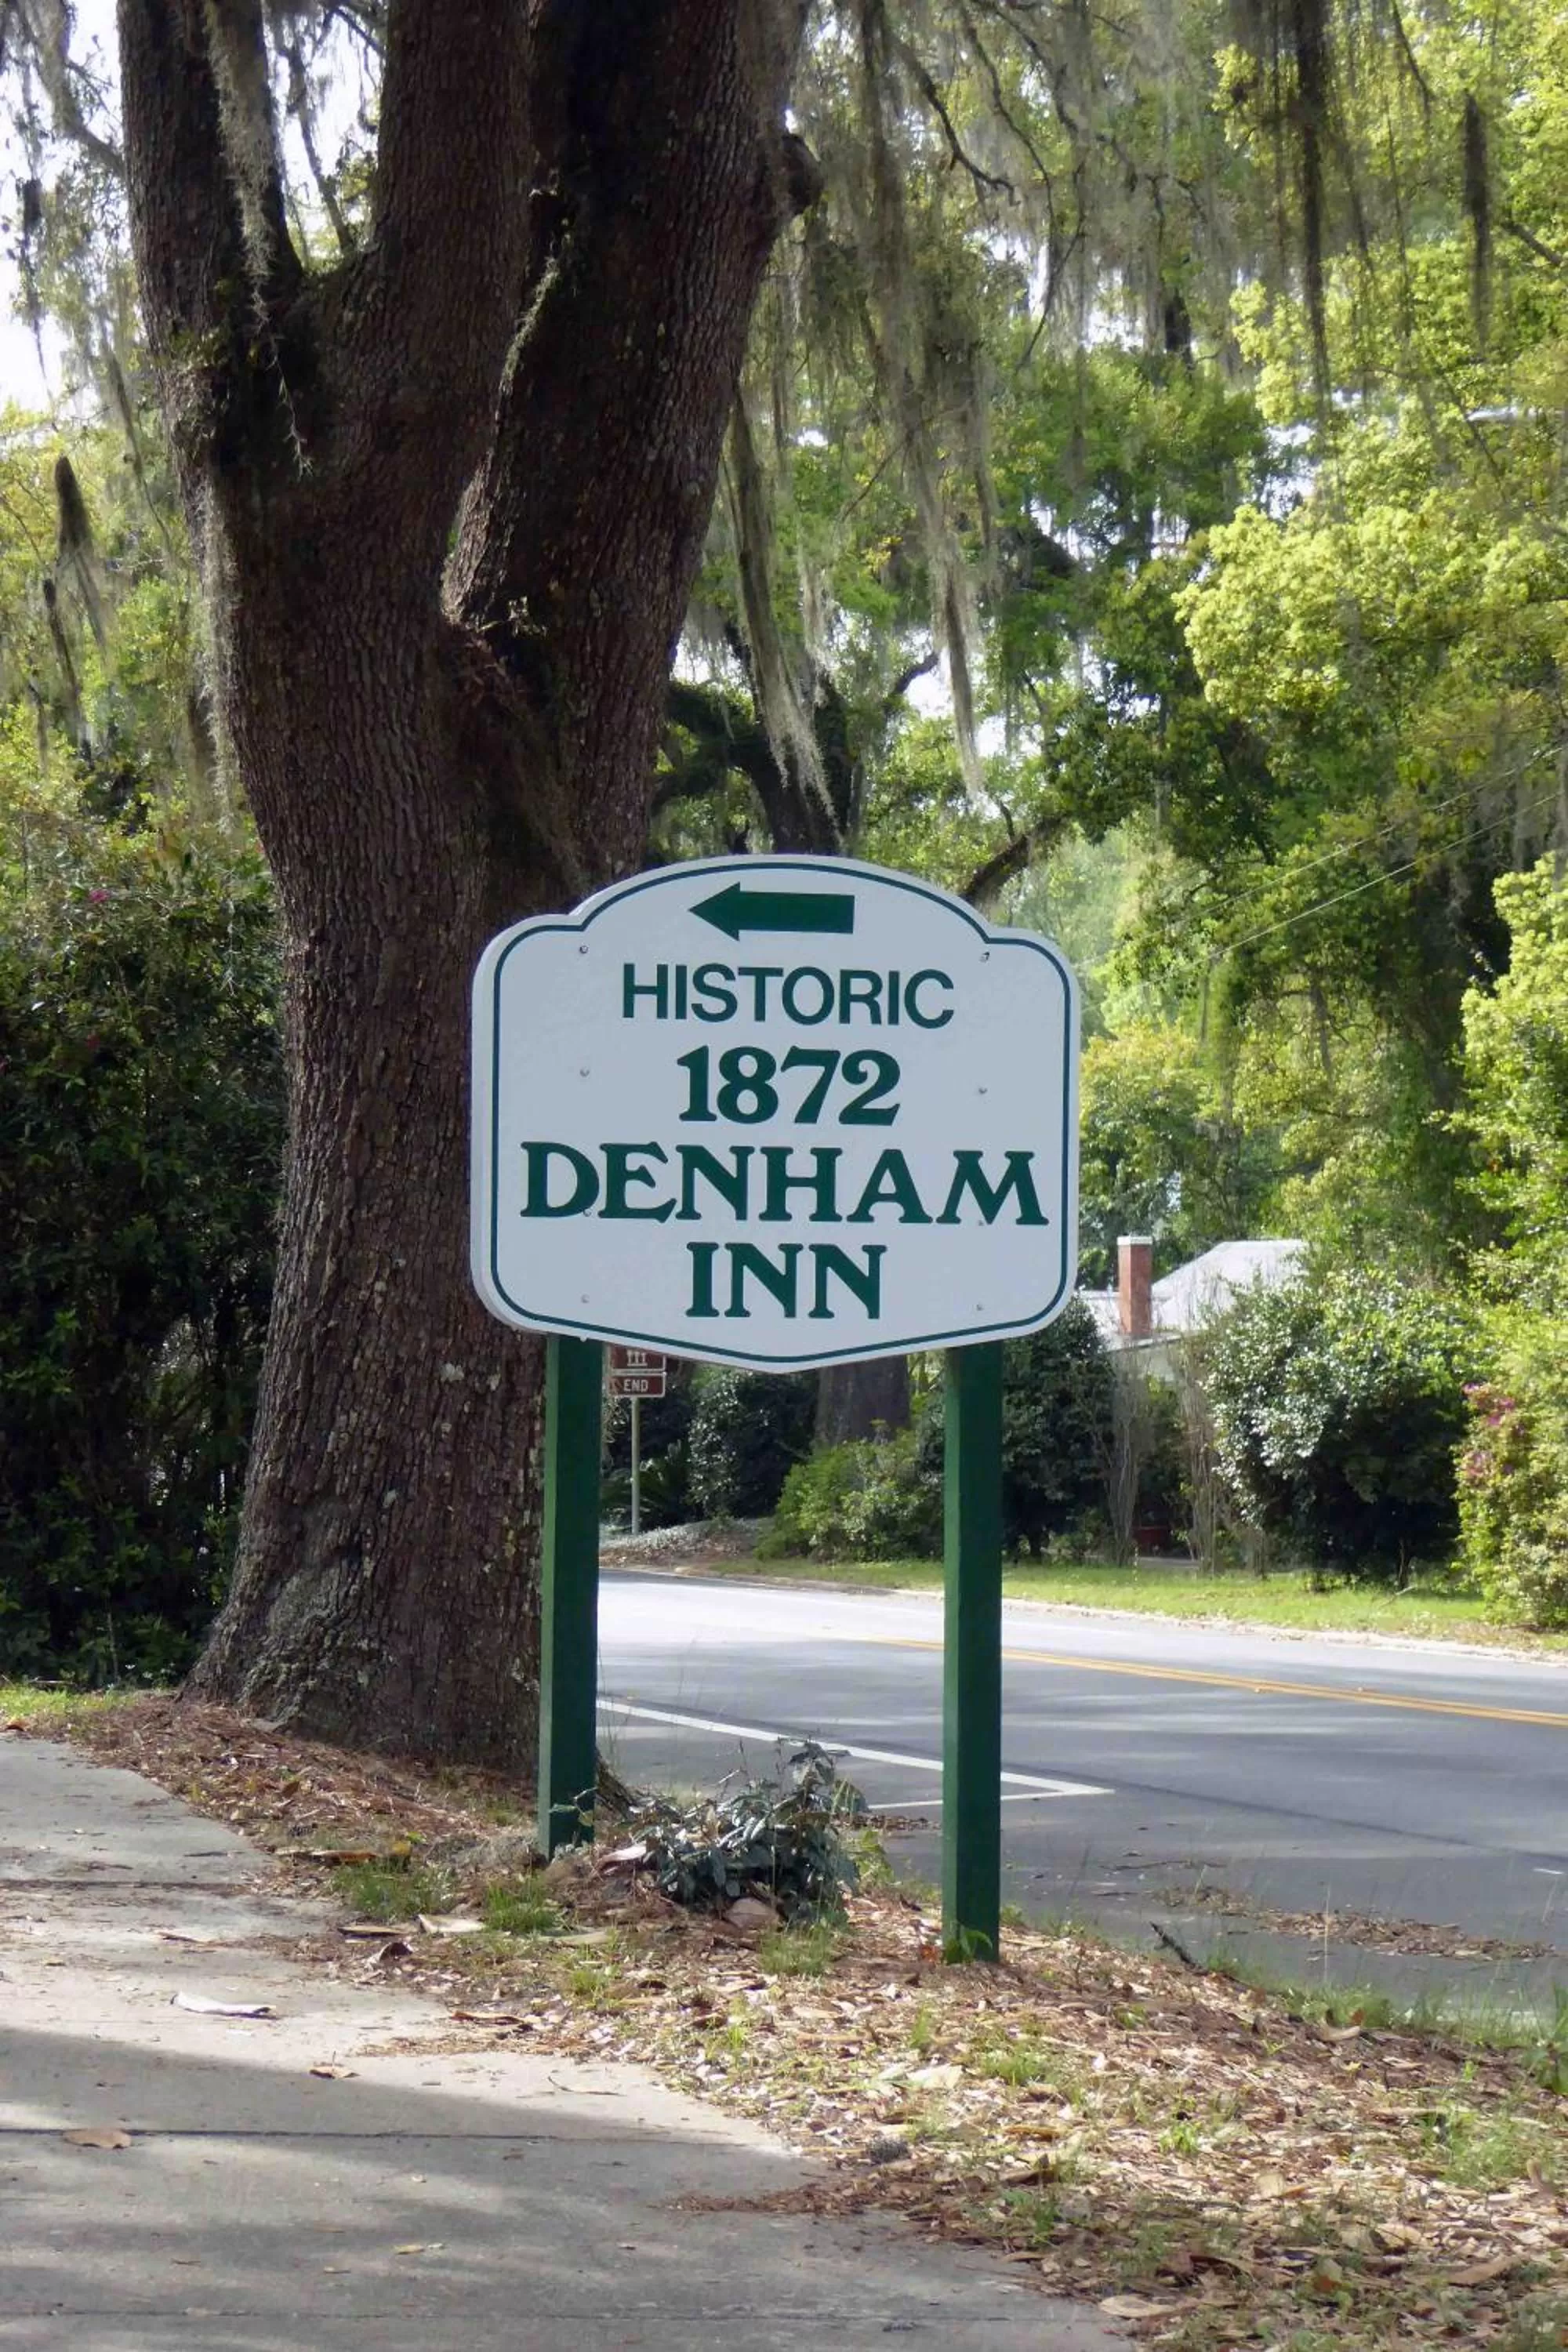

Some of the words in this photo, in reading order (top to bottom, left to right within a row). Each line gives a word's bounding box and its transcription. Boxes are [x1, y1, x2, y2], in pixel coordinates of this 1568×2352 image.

[622, 963, 953, 1029] HISTORIC
[677, 1045, 900, 1127] 1872
[521, 1142, 1049, 1225] DENHAM
[686, 1242, 887, 1319] INN
[623, 1379, 648, 1392] END
